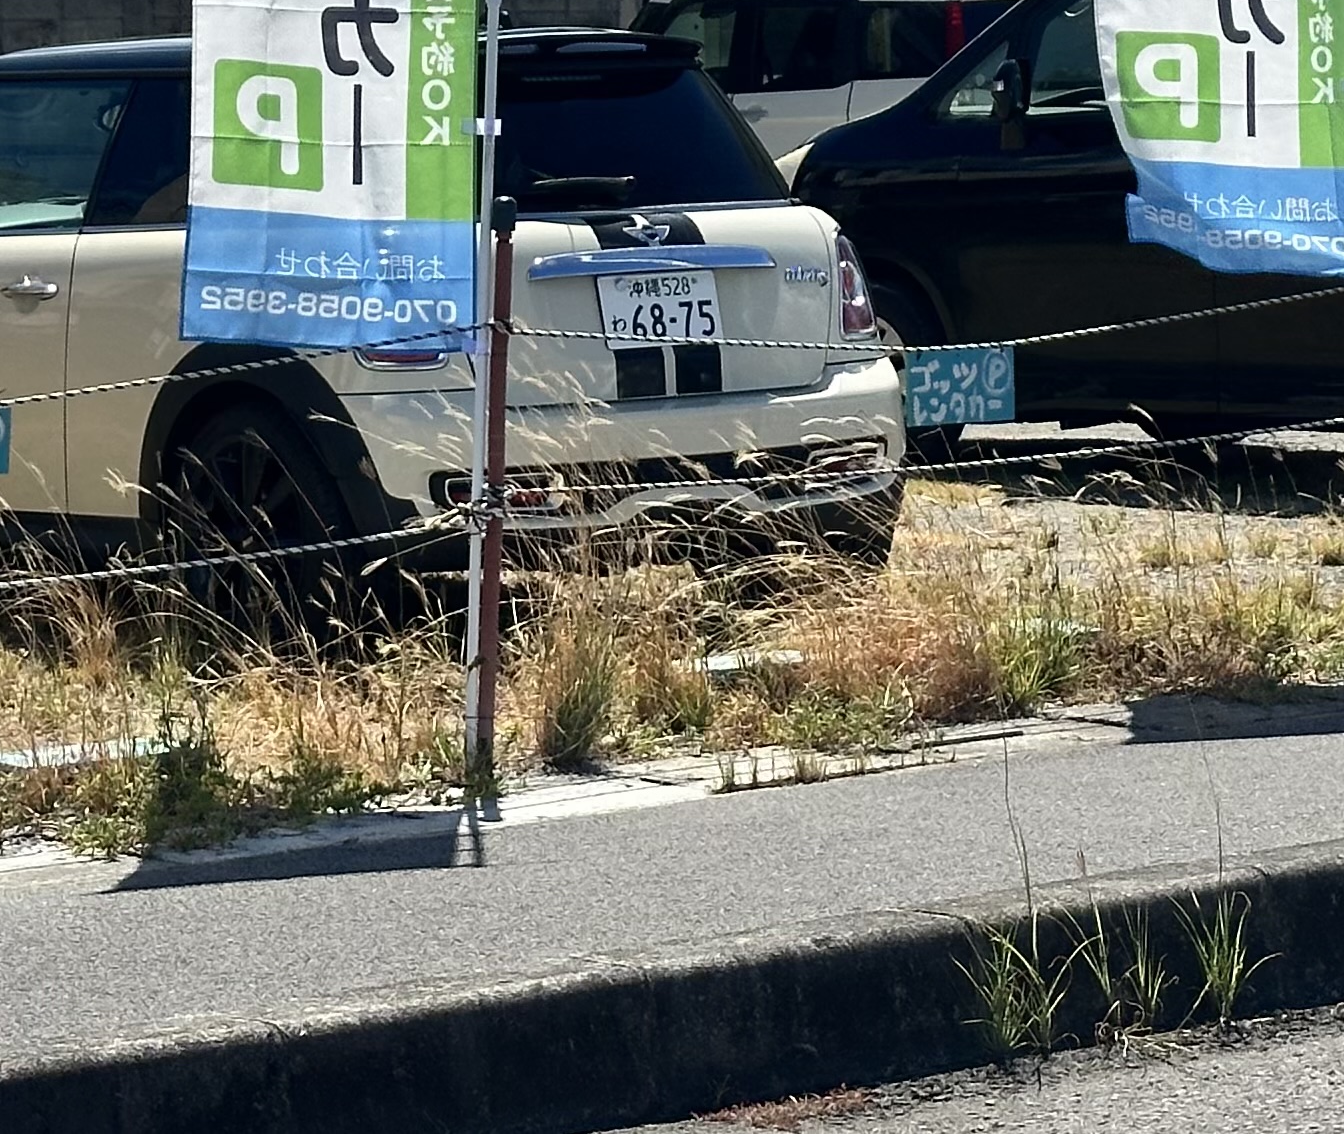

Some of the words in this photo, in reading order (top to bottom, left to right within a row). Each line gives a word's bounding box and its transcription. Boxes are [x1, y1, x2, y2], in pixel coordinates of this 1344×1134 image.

[633, 300, 715, 338] 68-75
[913, 387, 1003, 426] レンタカー
